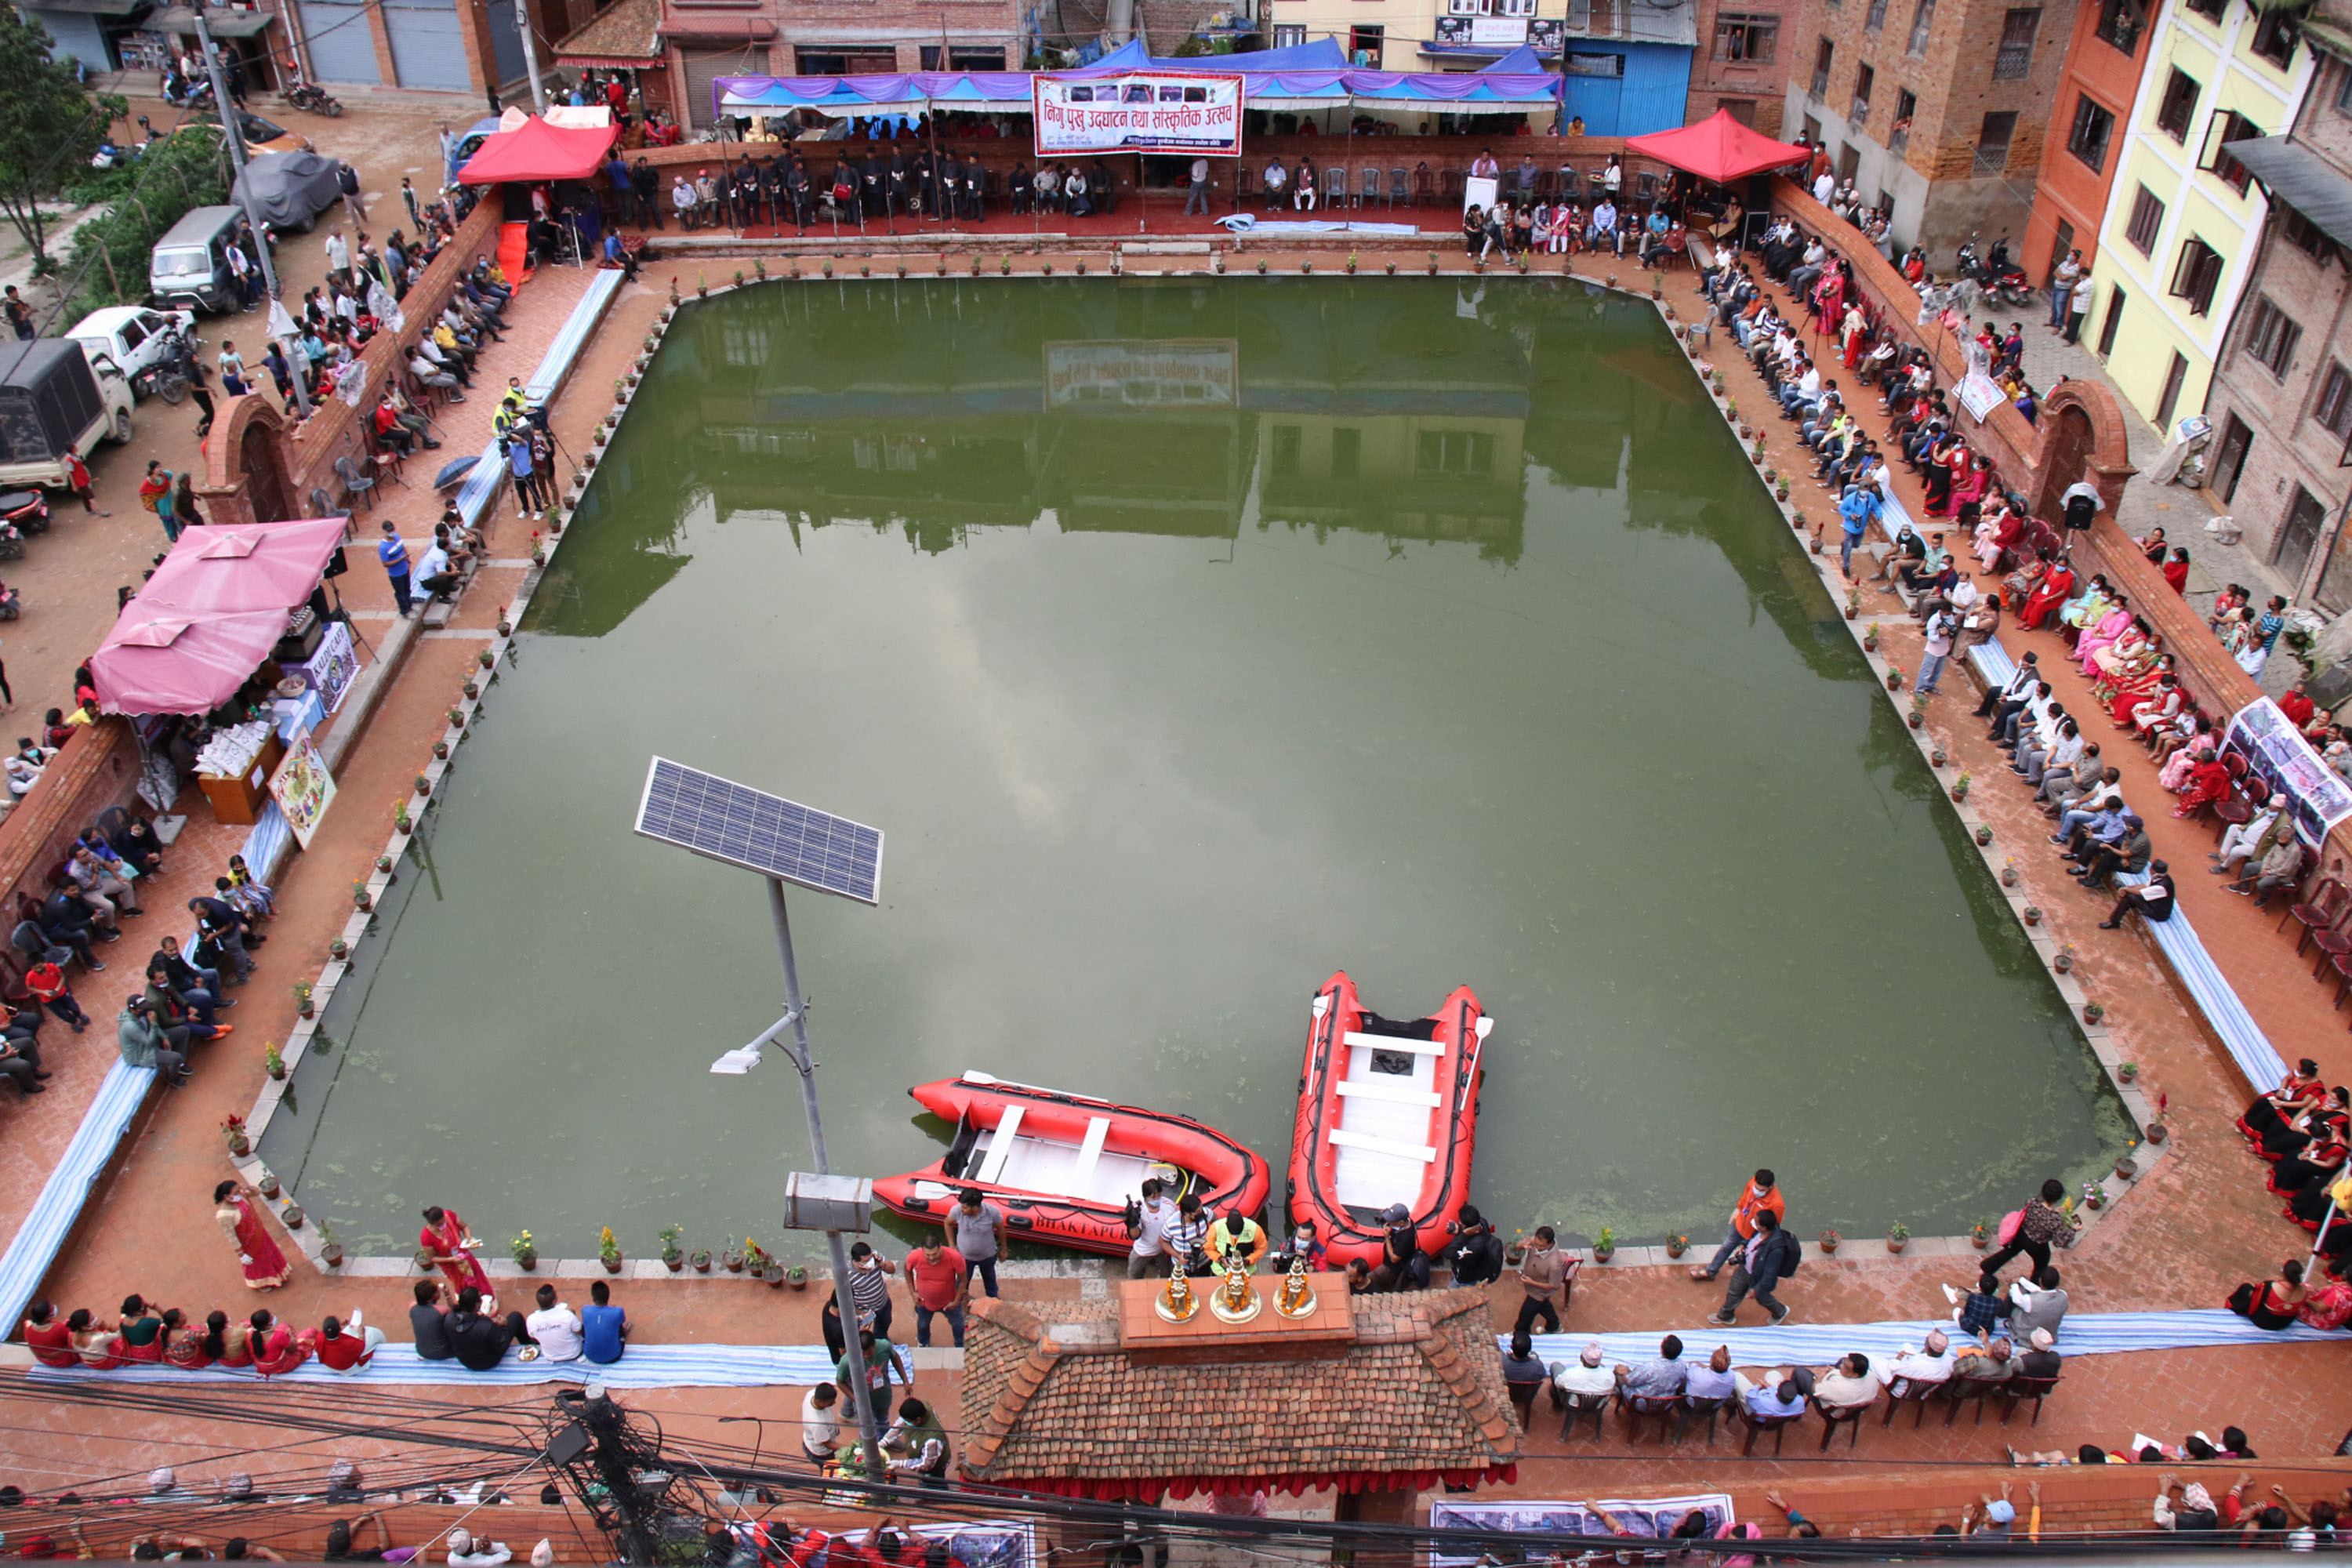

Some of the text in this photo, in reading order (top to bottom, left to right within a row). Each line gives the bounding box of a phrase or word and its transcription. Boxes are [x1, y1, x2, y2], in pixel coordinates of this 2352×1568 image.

[1044, 99, 1065, 129] निगु
[1067, 108, 1086, 132] पुखु
[1131, 111, 1149, 128] तथा
[1152, 104, 1201, 132] सांस्कृतिक
[1205, 105, 1233, 125] उत्सव
[313, 647, 332, 678] KALDI
[1036, 1216, 1131, 1241] BHAKTAPUR
